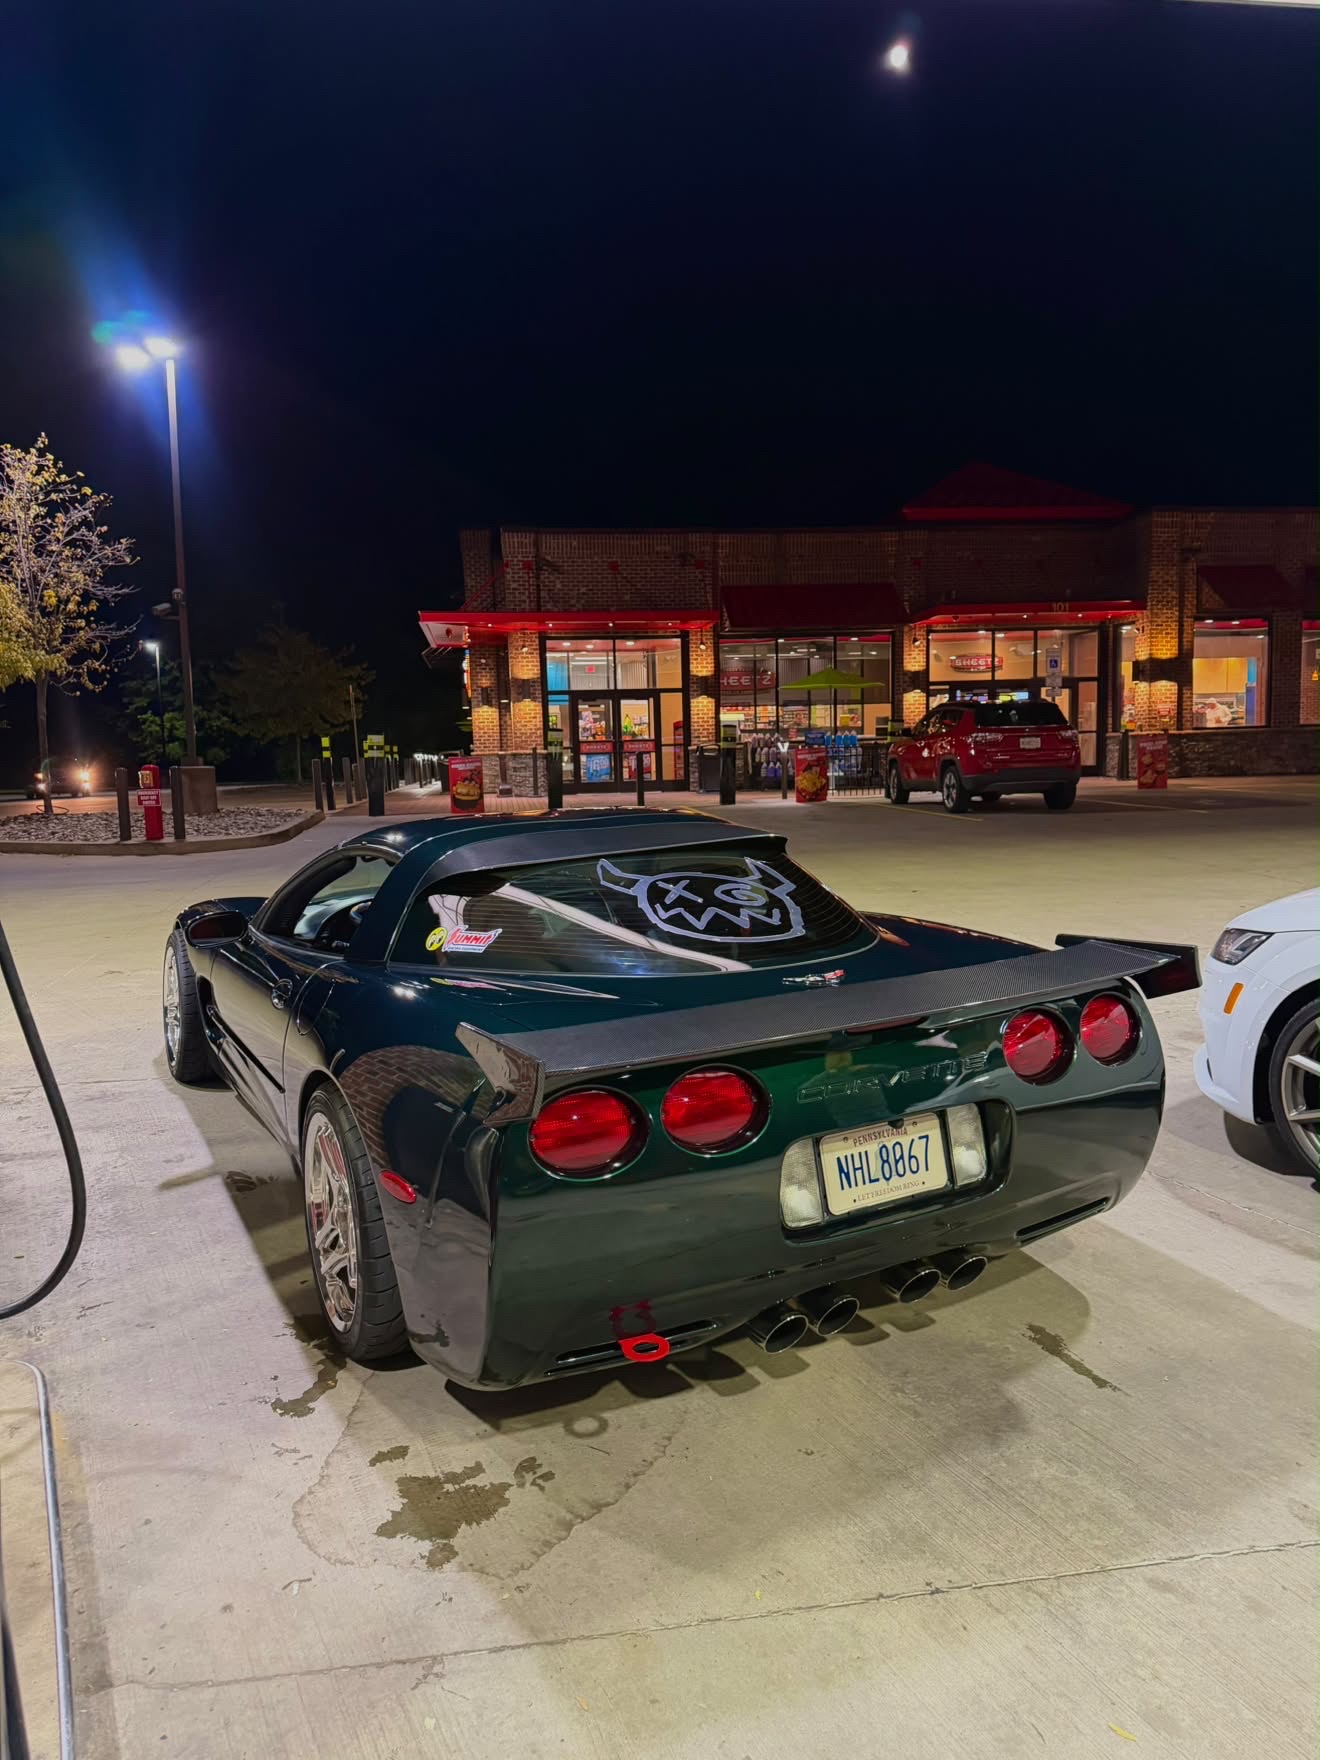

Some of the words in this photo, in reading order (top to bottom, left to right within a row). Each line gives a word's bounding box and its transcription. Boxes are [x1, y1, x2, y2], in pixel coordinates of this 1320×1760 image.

[1052, 602, 1070, 612] 101
[448, 928, 493, 945] SUMMIT
[852, 1127, 908, 1147] PENNSYLVANIA
[836, 1135, 930, 1191] NHL8067
